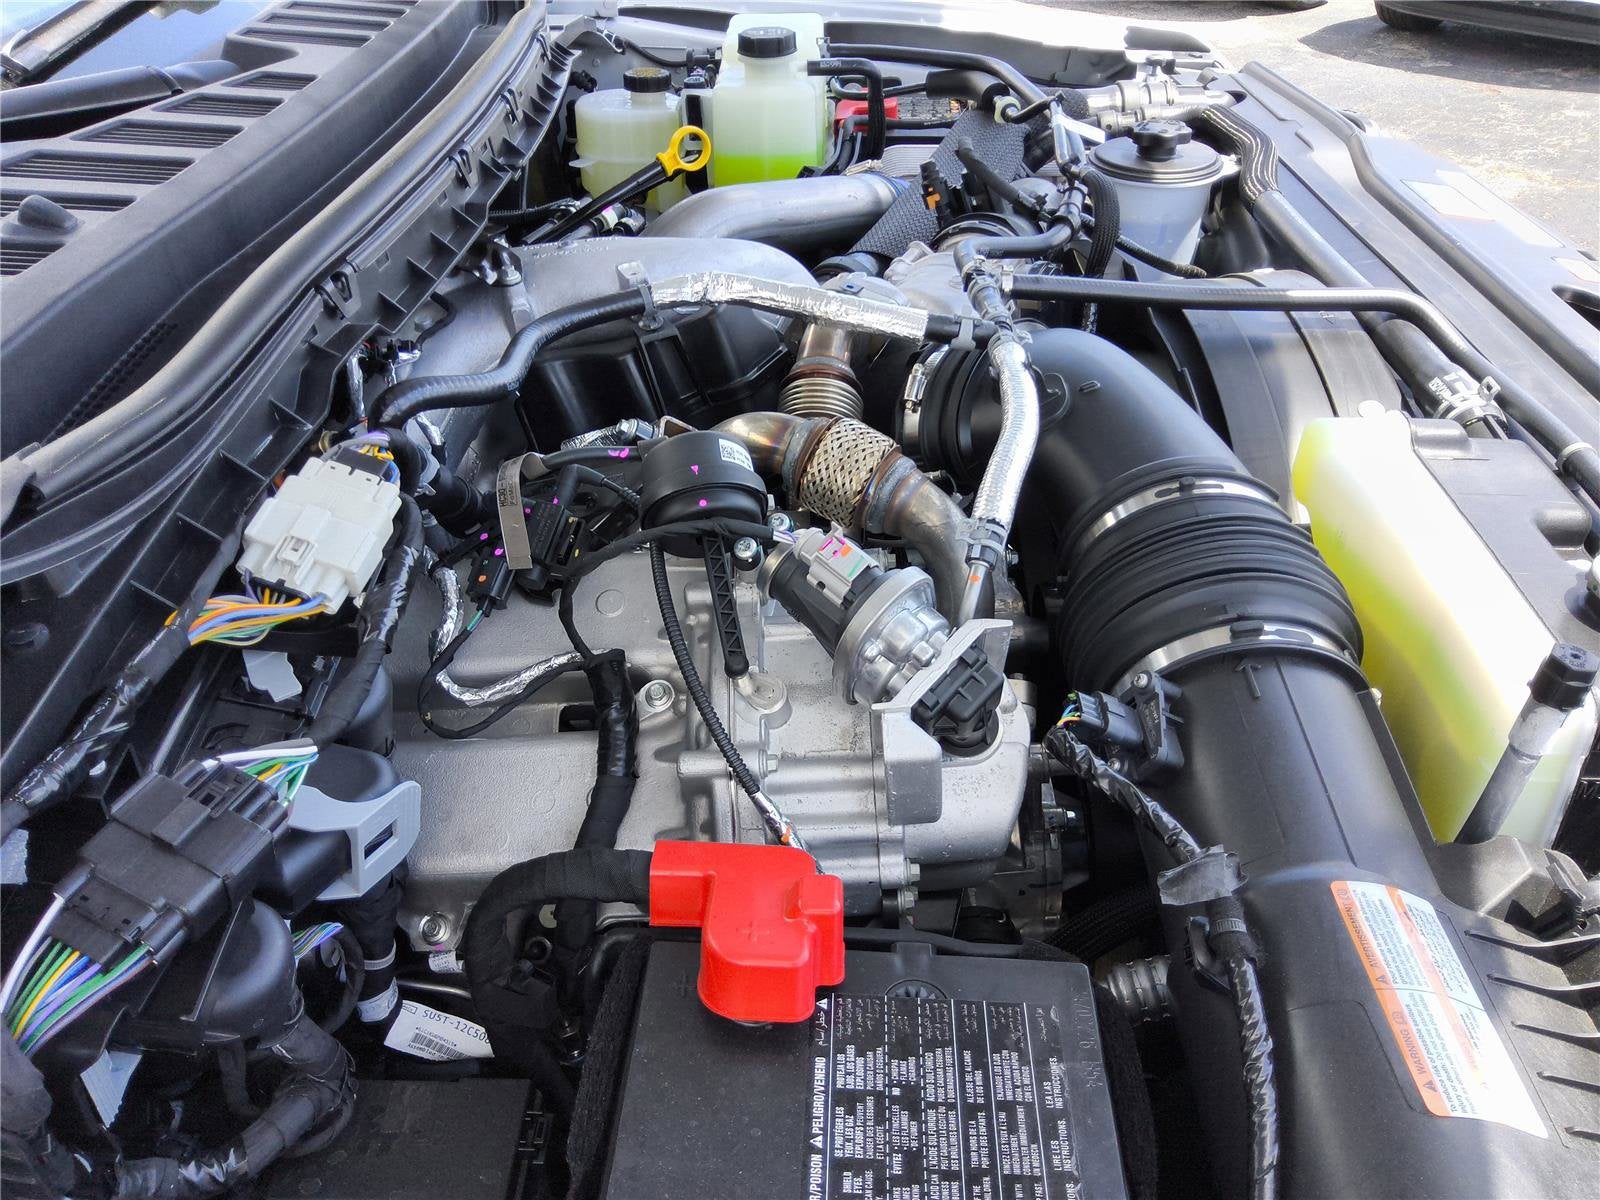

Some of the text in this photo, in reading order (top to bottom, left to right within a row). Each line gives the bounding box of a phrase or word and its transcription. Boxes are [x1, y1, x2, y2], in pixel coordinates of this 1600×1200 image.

[1343, 901, 1378, 968] AVERTISSEMENT
[1414, 1027, 1433, 1055] possible
[846, 1044, 855, 1061] GASES
[1002, 1050, 1010, 1060] CON
[1399, 1027, 1427, 1075] WARNING
[847, 1062, 855, 1072] LOS
[891, 1060, 899, 1080] CHISPAS
[963, 1050, 972, 1072] ALCANCE
[994, 1066, 1002, 1074] LOS
[836, 1054, 845, 1088] PROTEJA LOS
[856, 1057, 865, 1090] EXPLOSIVOS
[866, 1051, 874, 1090] PUEDEN CAUSAR
[936, 1068, 944, 1086] CAUSAR
[965, 1072, 973, 1082] DEL
[892, 1087, 901, 1096] NO
[976, 1086, 984, 1096] LOS
[995, 1076, 1004, 1100] ENJUAGUE
[1050, 1056, 1064, 1109] INSTRUCCIONES.
[1436, 1078, 1454, 1102] reduce
[812, 1057, 826, 1134] PELIGRO/VENENO
[976, 1096, 984, 1104] DE
[1024, 1092, 1032, 1102] CON
[1043, 1082, 1054, 1108] LEA LAS
[836, 1106, 845, 1117] LES
[845, 1114, 854, 1126] GAZ
[855, 1102, 864, 1158] EXPLOSIFS PEUVENT
[866, 1096, 874, 1159] CAUSER DES BLESSURES
[900, 1111, 909, 1136] FLAMMES
[910, 1121, 918, 1139] FUMER
[928, 1109, 938, 1146] SULFURIQUE
[968, 1127, 977, 1135] DE
[832, 1118, 844, 1149] PROTÉGER
[845, 1128, 854, 1138] LES
[892, 1136, 900, 1146] LES
[979, 1136, 988, 1146] DES
[1000, 1130, 1009, 1144] YEUX
[876, 1144, 884, 1152] LA
[940, 1137, 948, 1156] CAUSER
[970, 1136, 978, 1150] HORS
[1001, 1144, 1010, 1154] LES
[1058, 1118, 1072, 1172] INSTRUCTIONS.
[890, 1154, 902, 1174] ÉVITEZ
[940, 1157, 949, 1170] PEUT
[970, 1152, 980, 1168] TENIR
[1002, 1155, 1012, 1174] RINCEZ
[1021, 1146, 1032, 1176] CONSULTER
[1050, 1140, 1062, 1171] LIRE LES
[951, 1160, 959, 1170] DES
[1033, 1168, 1041, 1176] UN
[843, 1172, 852, 1193] SHIELD
[930, 1174, 940, 1200] ACID CAN
[972, 1186, 981, 1196] THE
